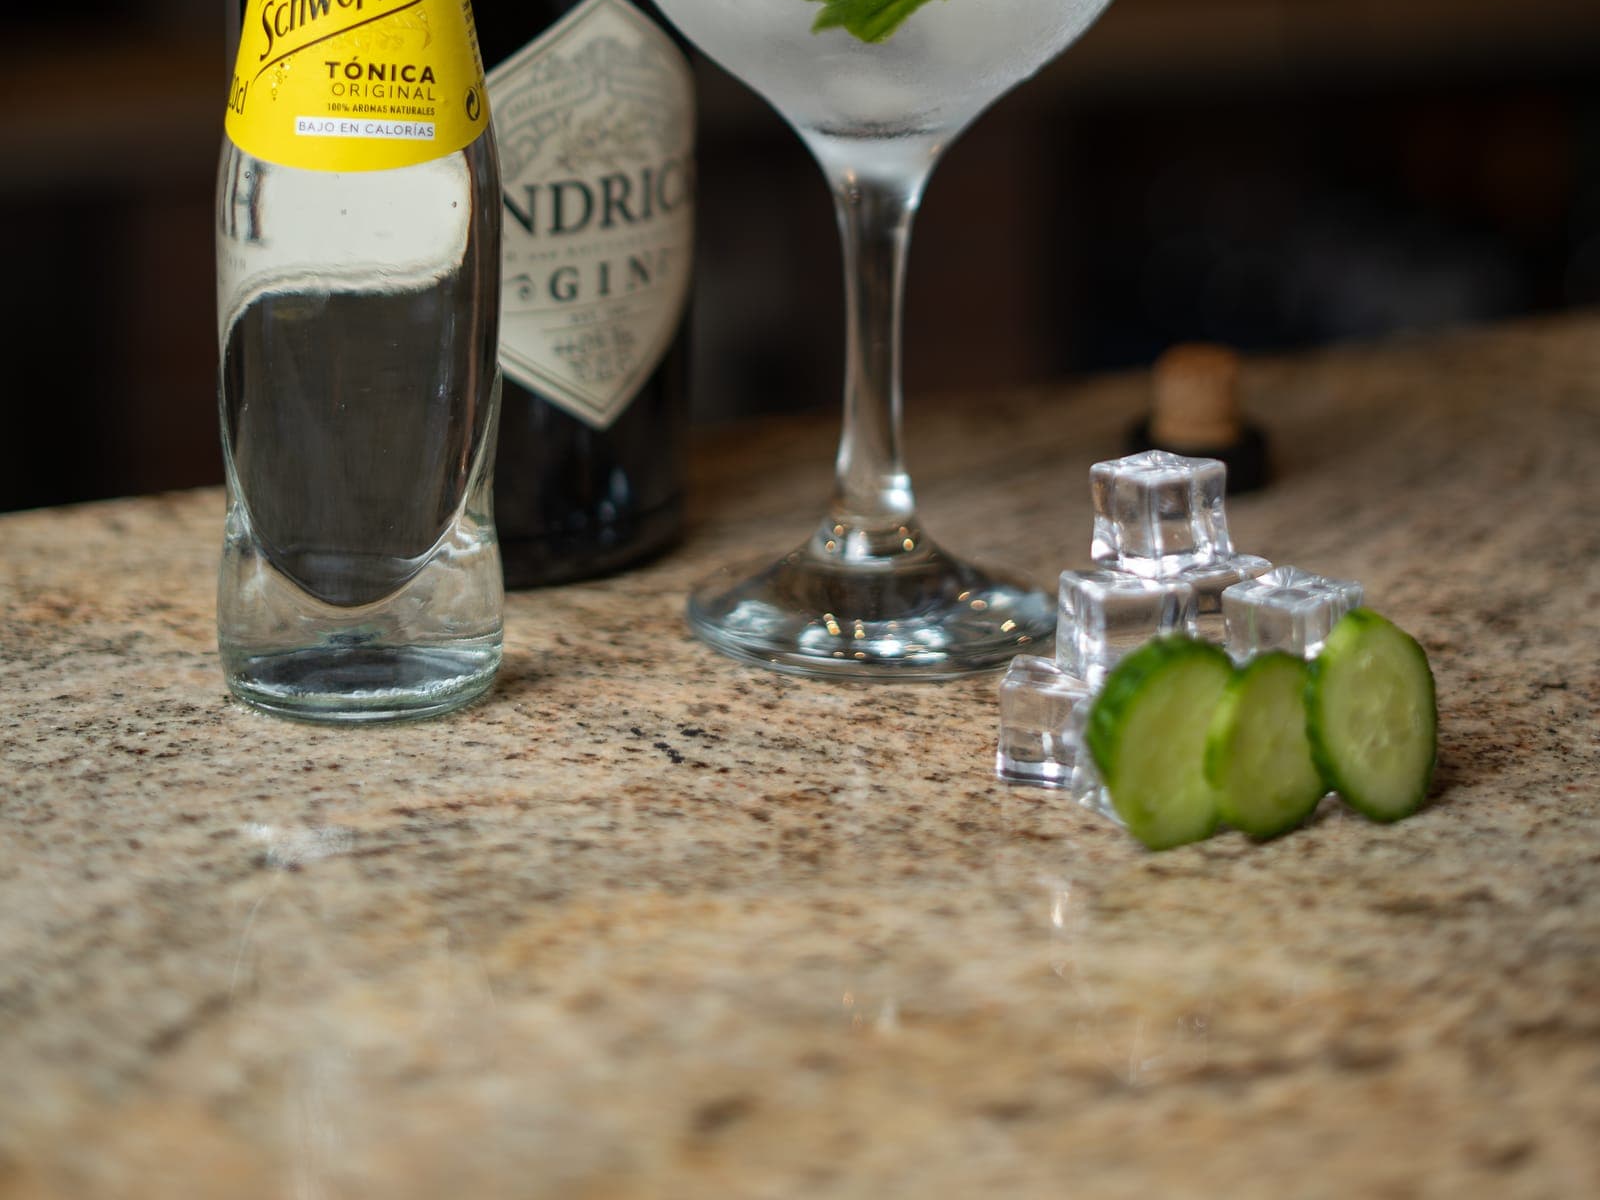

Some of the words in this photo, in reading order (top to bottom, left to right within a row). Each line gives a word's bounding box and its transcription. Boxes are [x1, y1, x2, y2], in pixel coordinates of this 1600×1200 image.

[325, 56, 436, 84] TÓNICA
[331, 82, 436, 101] ORIGINAL
[328, 103, 350, 113] 100%
[352, 103, 388, 115] AROMAS
[390, 104, 435, 117] NATURALES
[299, 121, 335, 133] BAJO
[340, 122, 359, 134] EN
[365, 122, 434, 138] CALORÍAS
[549, 251, 655, 302] GIN
